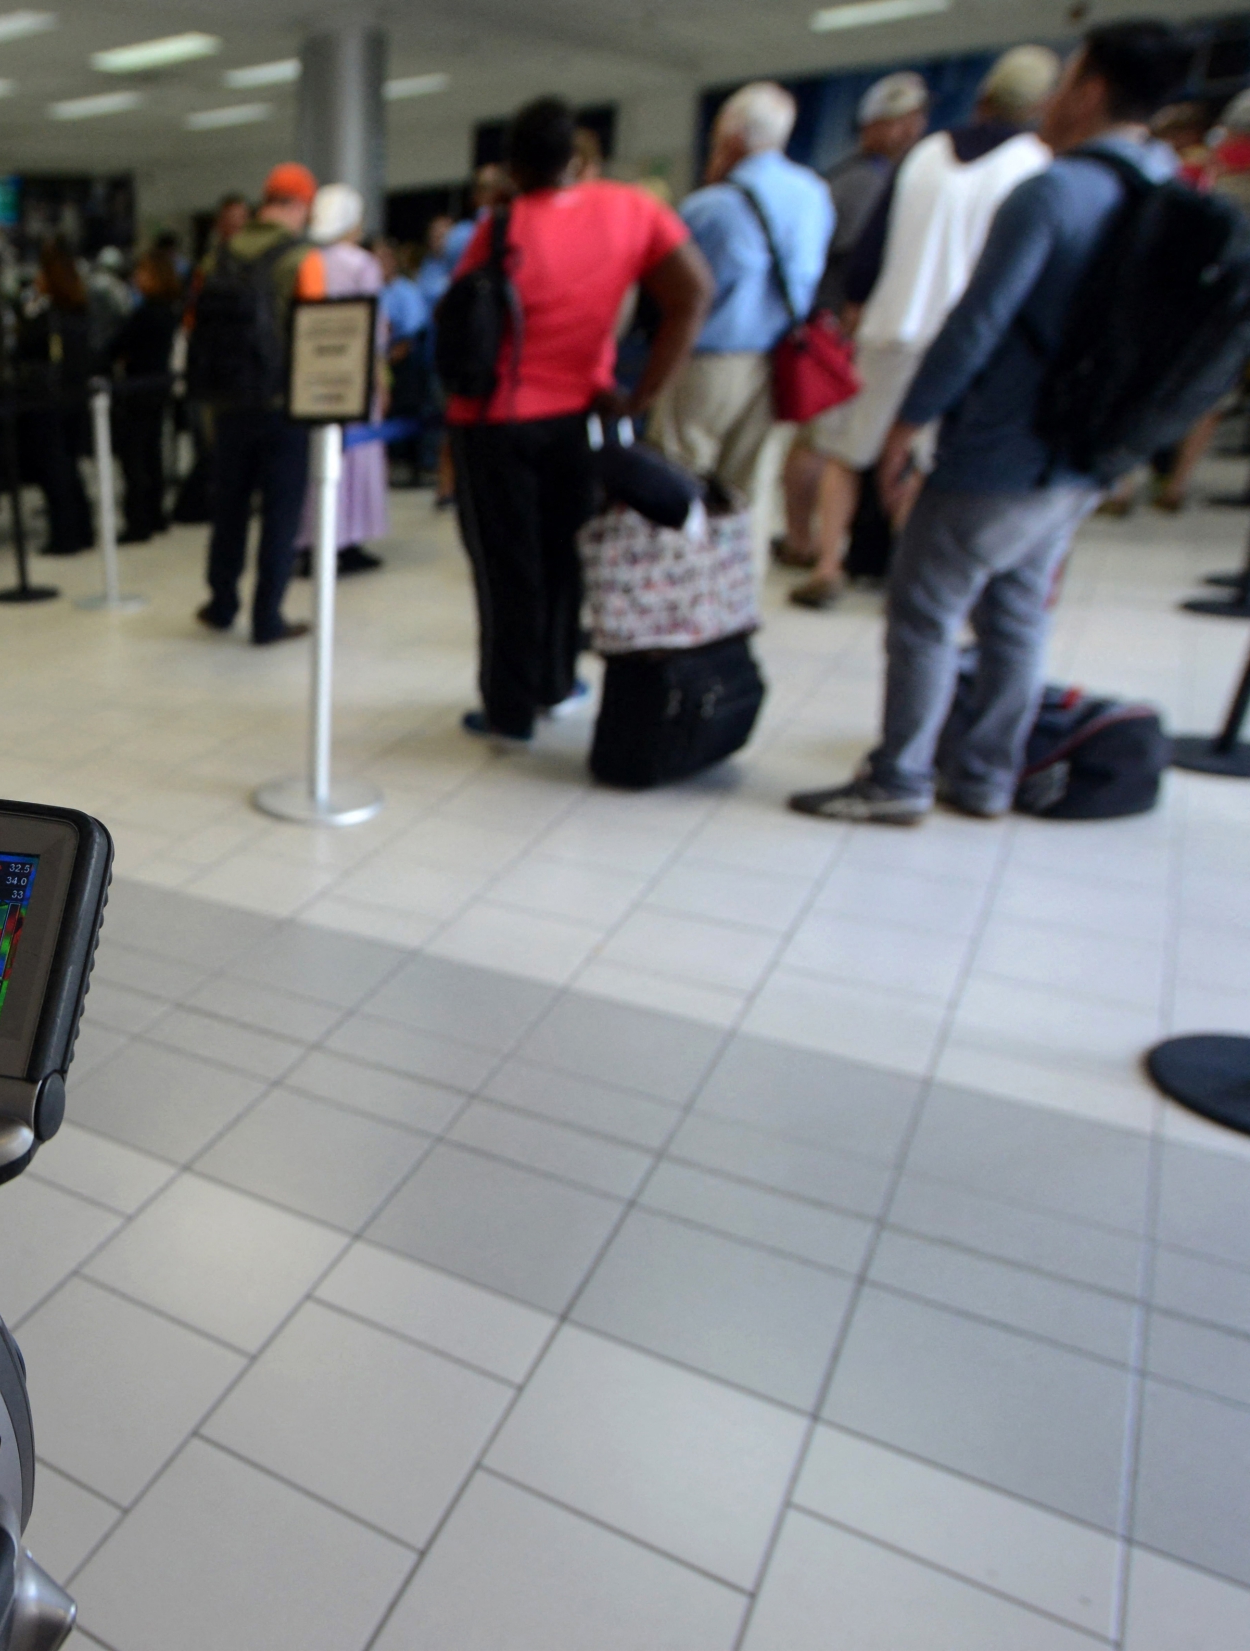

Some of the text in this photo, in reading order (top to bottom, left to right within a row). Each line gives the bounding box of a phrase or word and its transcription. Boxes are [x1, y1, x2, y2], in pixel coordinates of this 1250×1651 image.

[9, 863, 30, 874] 32.5
[6, 876, 28, 886] 34.0
[11, 890, 24, 899] 33
